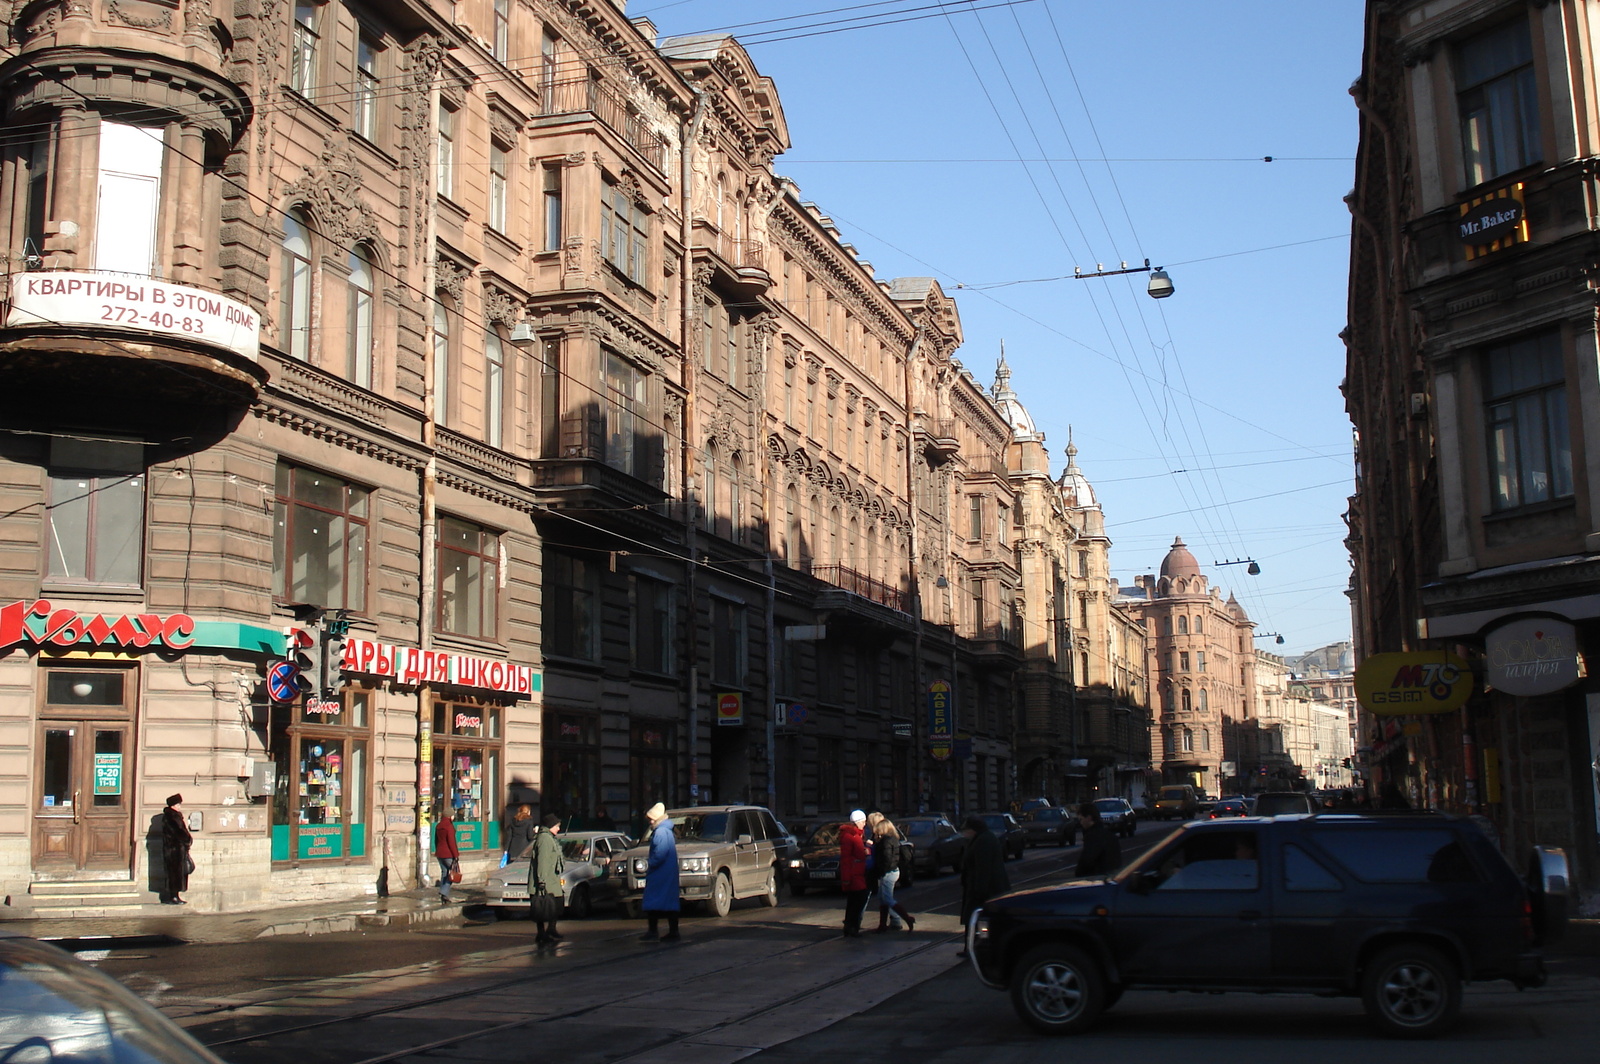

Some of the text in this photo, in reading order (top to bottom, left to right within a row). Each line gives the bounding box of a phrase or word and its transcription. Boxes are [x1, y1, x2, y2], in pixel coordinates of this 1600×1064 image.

[1460, 208, 1517, 238] Mr. Baker
[27, 279, 254, 332] КВАРТИРЫ В ЭТОМ ДОМЕ
[101, 305, 204, 334] 272-40-83
[398, 647, 450, 686] ДЛЯ
[452, 655, 532, 694] ШКОЛЫ
[1372, 690, 1422, 704] GSM
[933, 692, 947, 734] ДВЕРИ
[97, 768, 119, 777] 9-20
